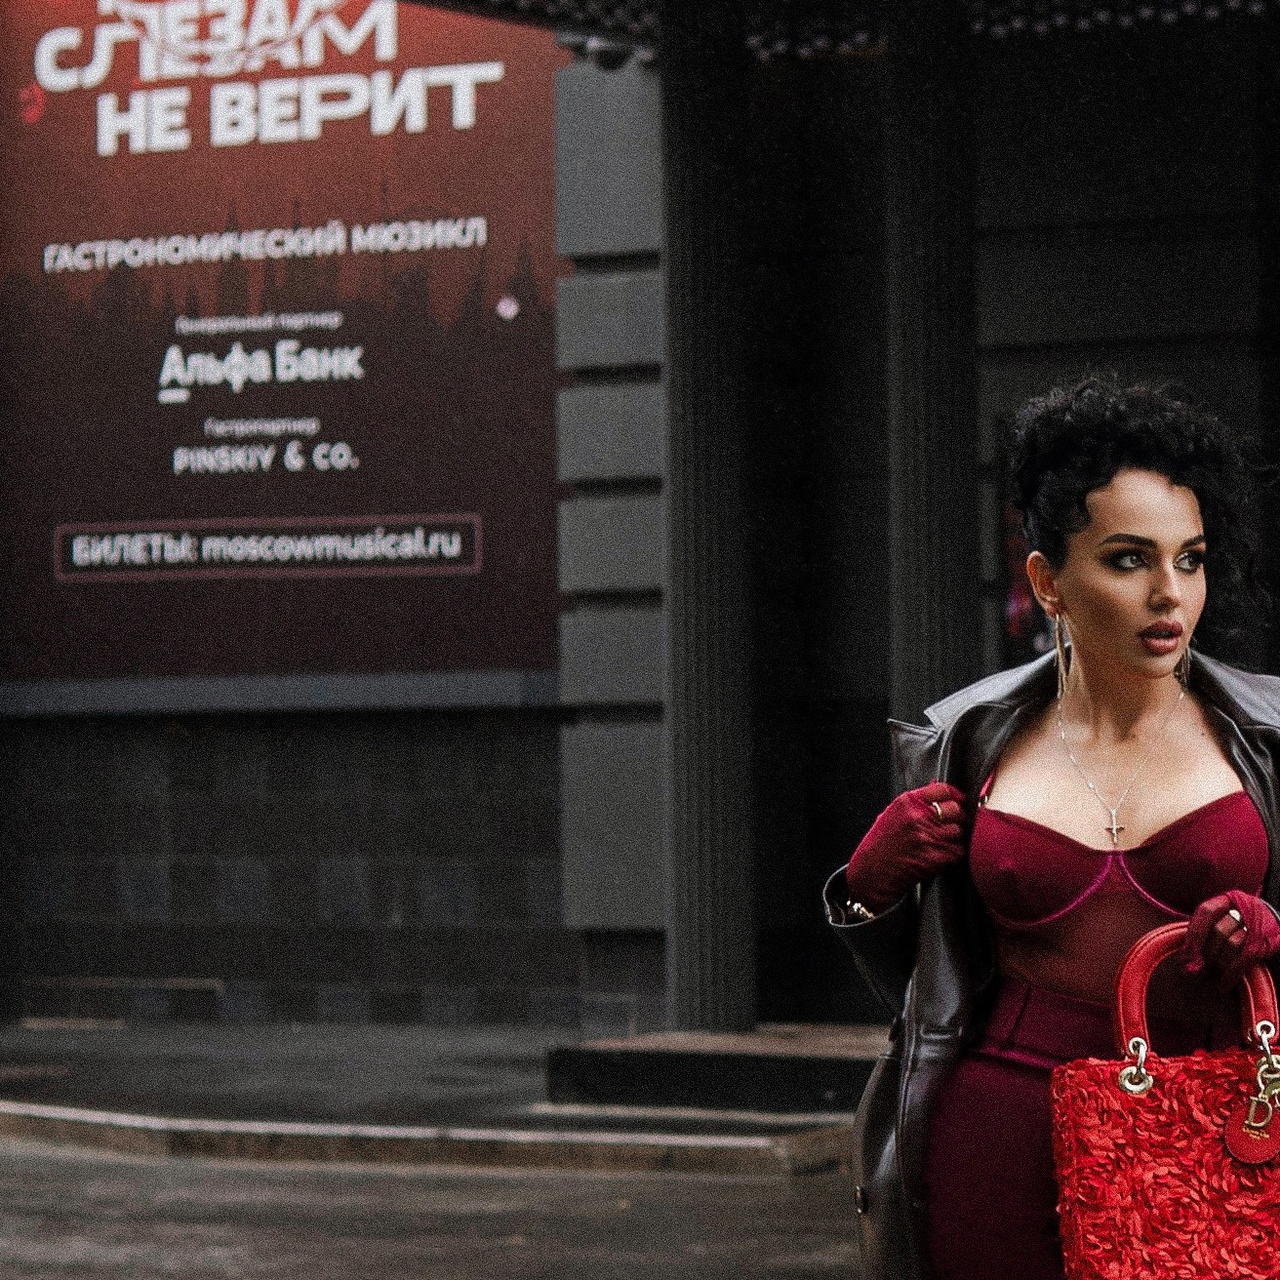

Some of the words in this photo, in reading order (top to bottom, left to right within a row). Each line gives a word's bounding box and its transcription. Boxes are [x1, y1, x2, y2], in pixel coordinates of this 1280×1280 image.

[97, 86, 193, 157] НЕ
[210, 60, 506, 148] ВЕРИТ
[43, 219, 346, 274] ГАСТРОНОМИЧЕСКИЙ
[351, 216, 488, 253] МЮЗИКЛ
[158, 340, 272, 395] Альфа
[274, 338, 366, 384] Банк
[284, 439, 306, 472] &
[312, 441, 360, 472] CO.
[72, 532, 198, 567] БИЛЕТЫ:
[203, 526, 462, 562] moscowmusical.ru
